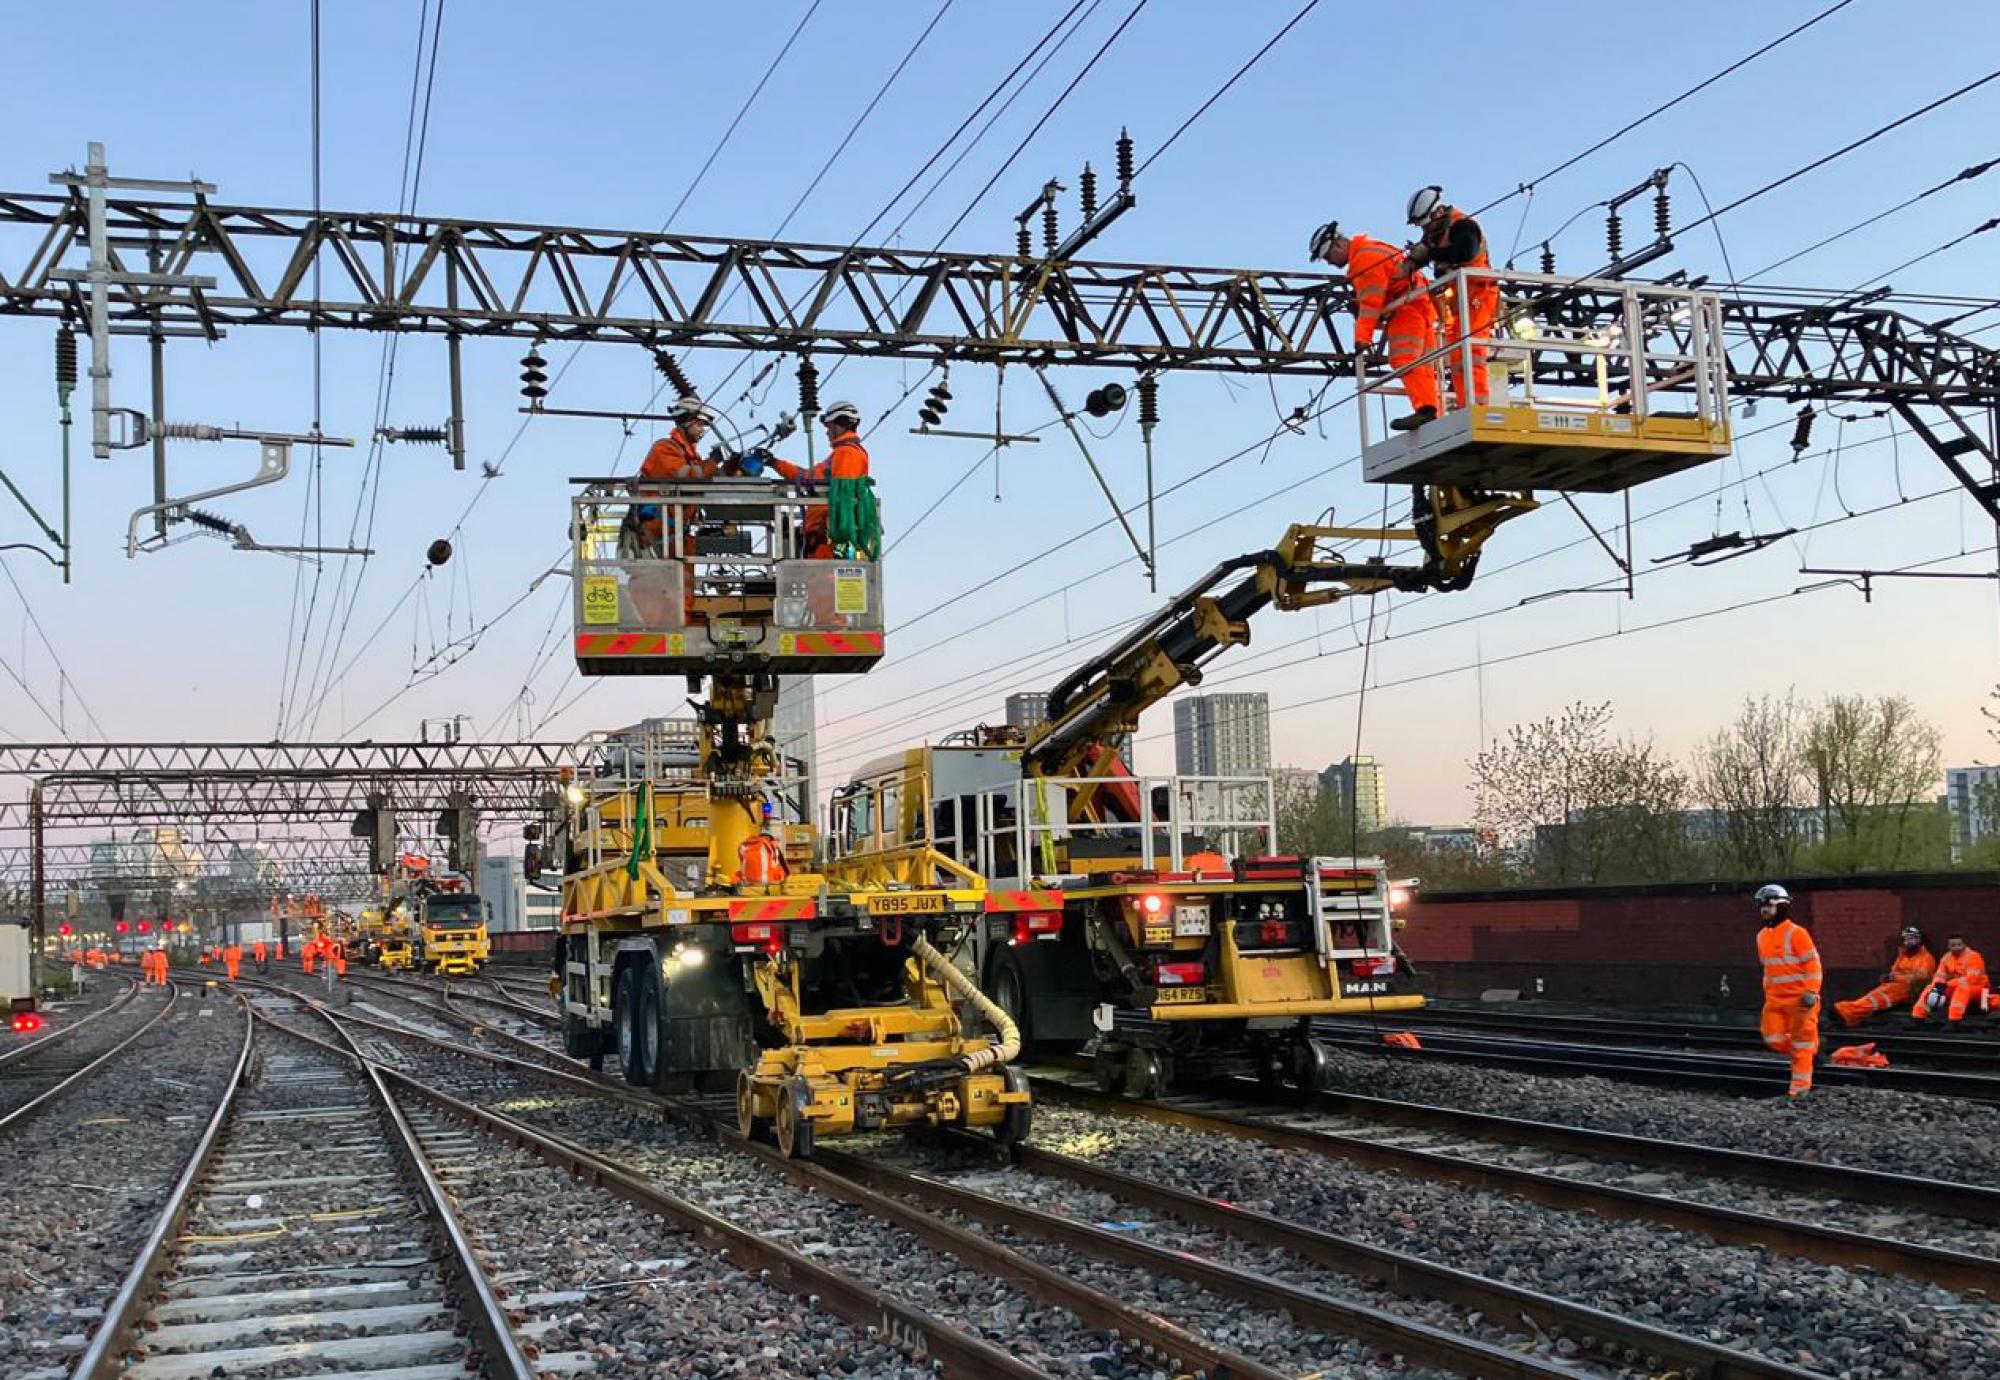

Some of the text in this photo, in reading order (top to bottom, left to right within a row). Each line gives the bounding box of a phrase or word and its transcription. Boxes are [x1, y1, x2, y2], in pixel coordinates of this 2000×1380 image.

[872, 896, 937, 912] Y895 JUX
[1346, 982, 1386, 993] MAN
